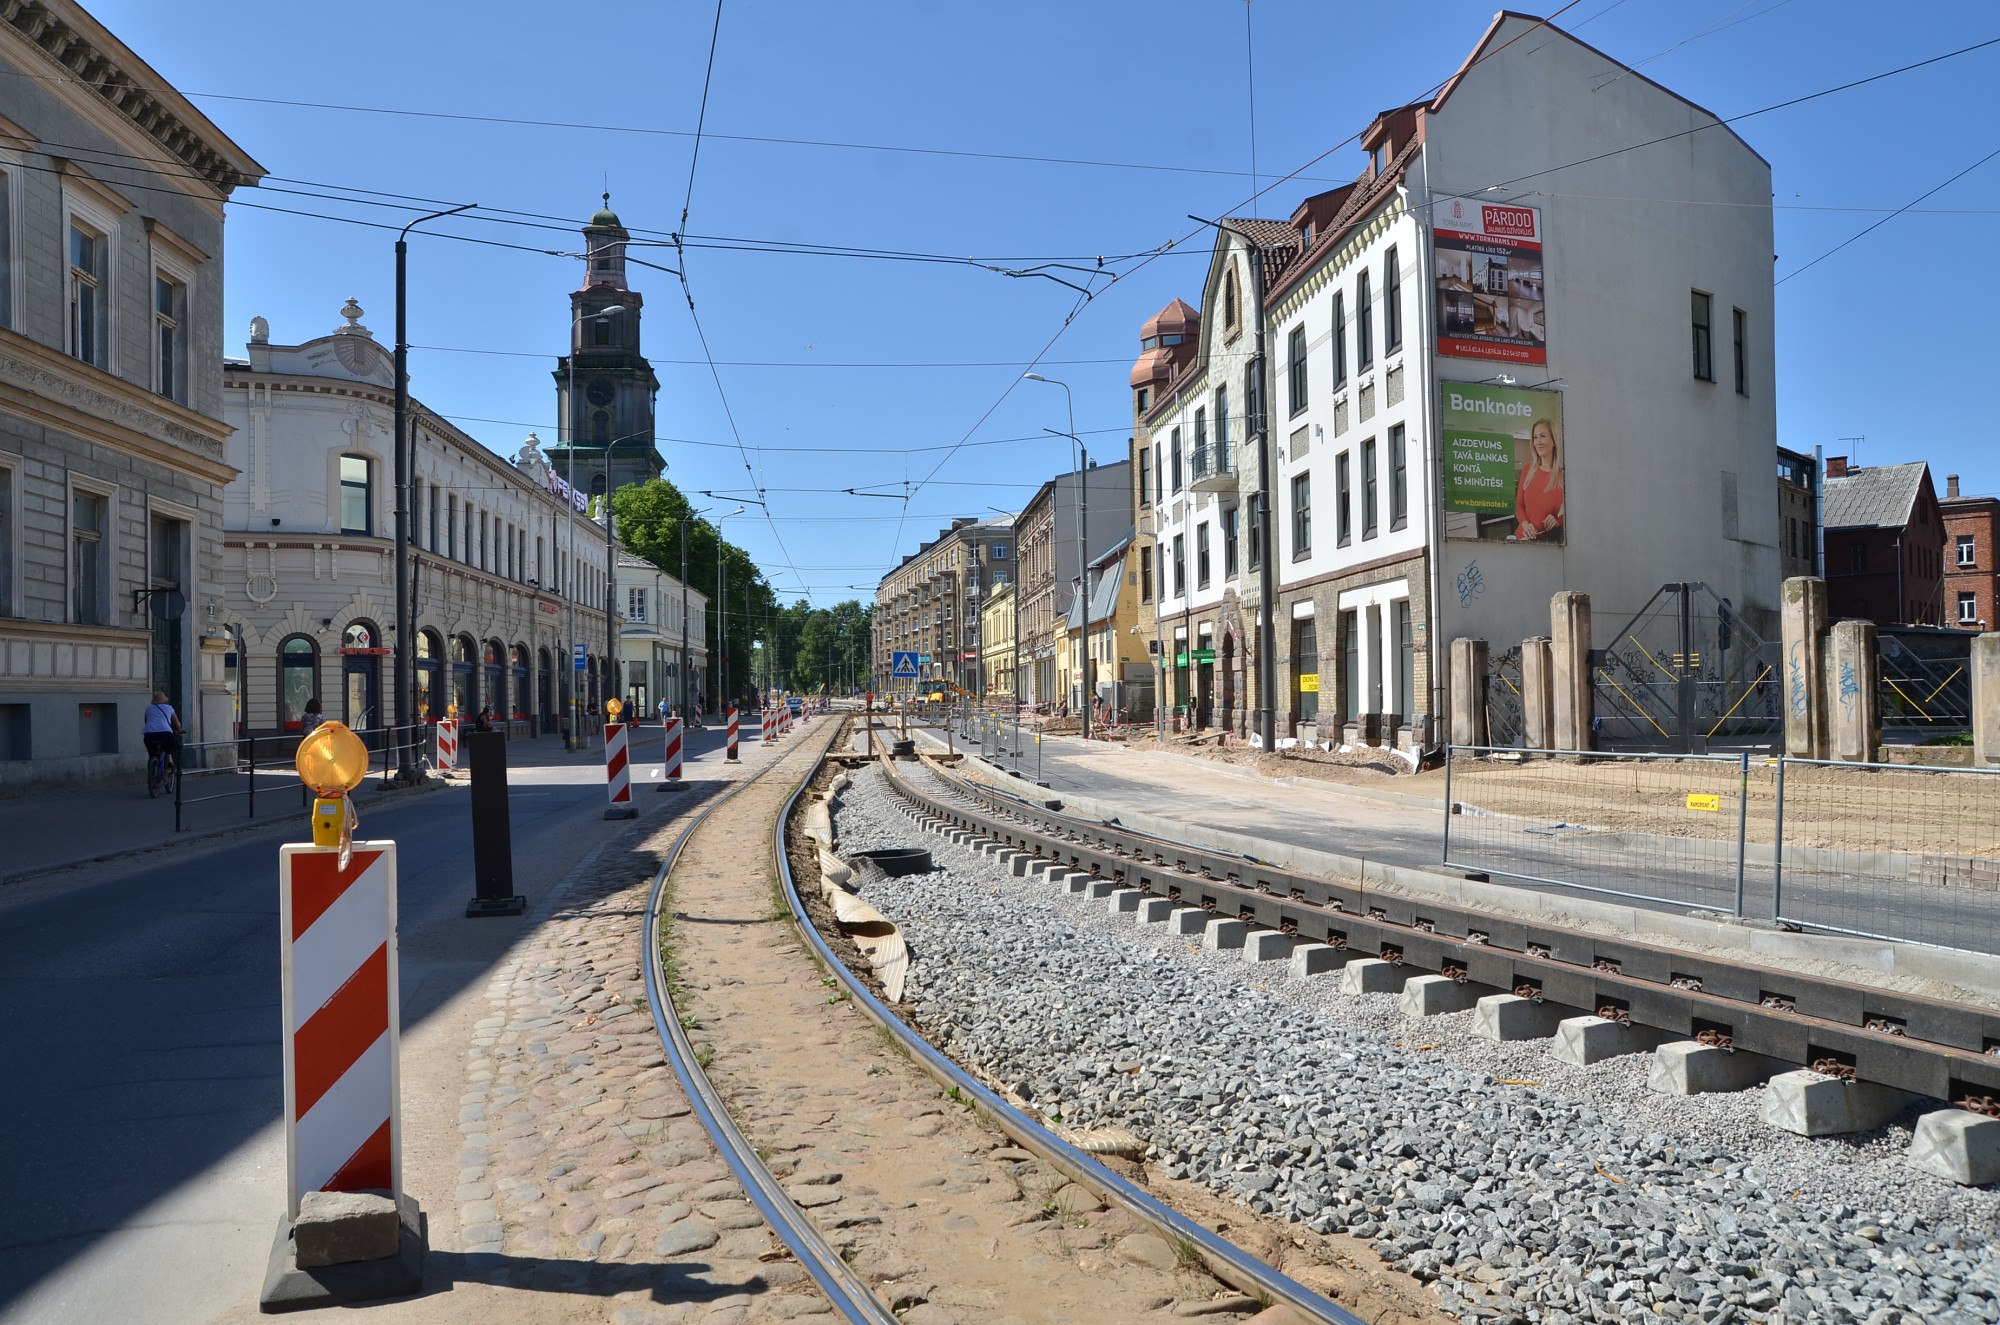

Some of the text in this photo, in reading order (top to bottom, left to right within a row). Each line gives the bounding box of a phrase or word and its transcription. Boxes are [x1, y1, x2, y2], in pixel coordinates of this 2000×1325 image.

[1485, 208, 1531, 227] PĀRDOD
[1487, 226, 1506, 234] JAUNUS
[1458, 233, 1518, 246] WWW.TORNANAMS.LV
[1450, 393, 1532, 417] Banknote
[1452, 438, 1502, 450] AIZDEVUMS
[1453, 450, 1508, 463] TAVĀ BANKAS
[1453, 463, 1481, 473] KONTĀ
[1454, 476, 1503, 488] 15 MINŪTĒS!
[1455, 499, 1508, 508] www.banknote.lv
